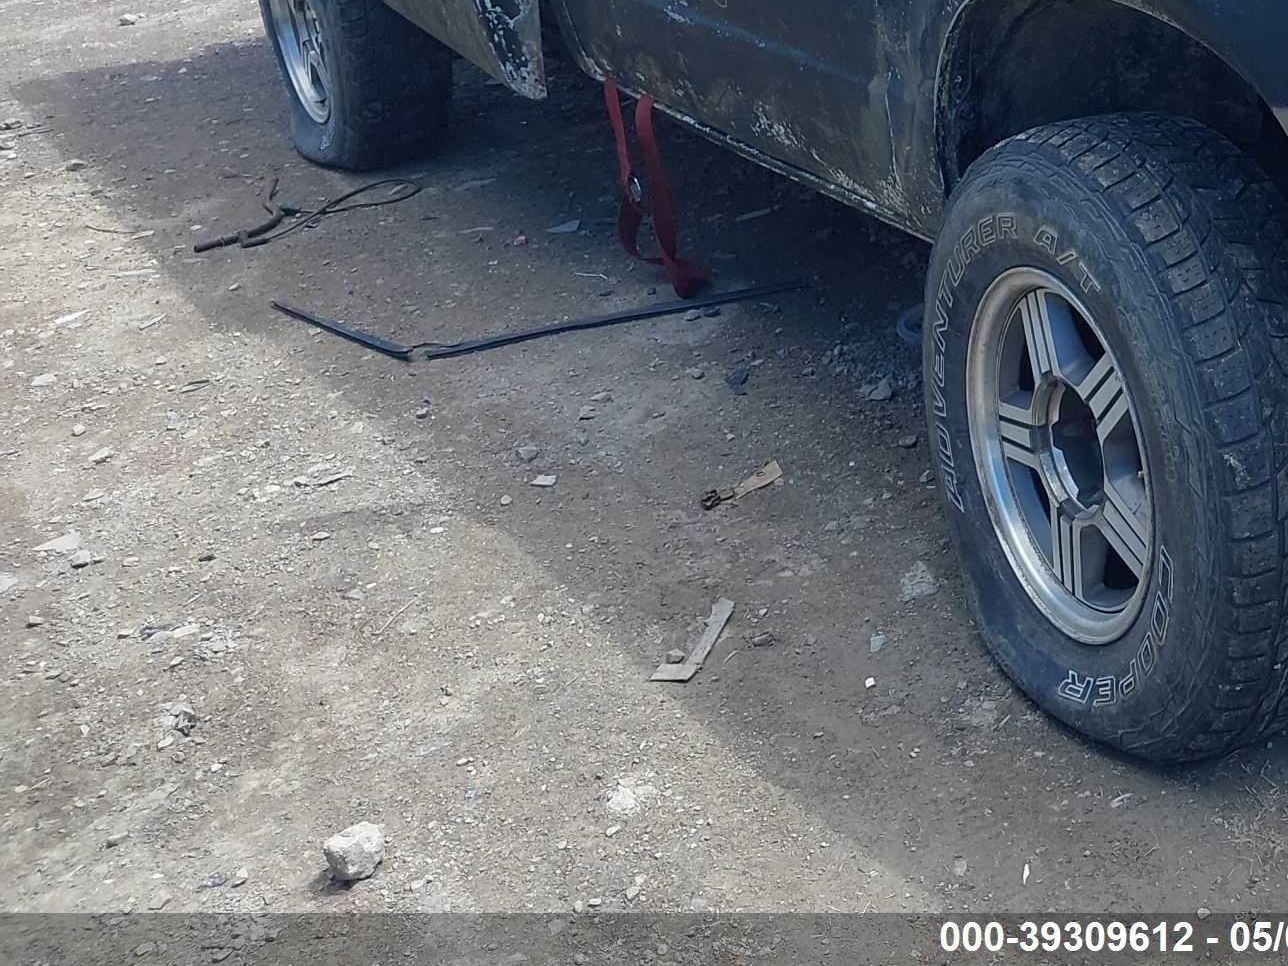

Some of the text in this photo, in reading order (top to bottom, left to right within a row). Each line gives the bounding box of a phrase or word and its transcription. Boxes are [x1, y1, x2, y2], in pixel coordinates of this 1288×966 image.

[929, 212, 1102, 514] ADVENTURER A/T
[1056, 544, 1174, 707] COOPER
